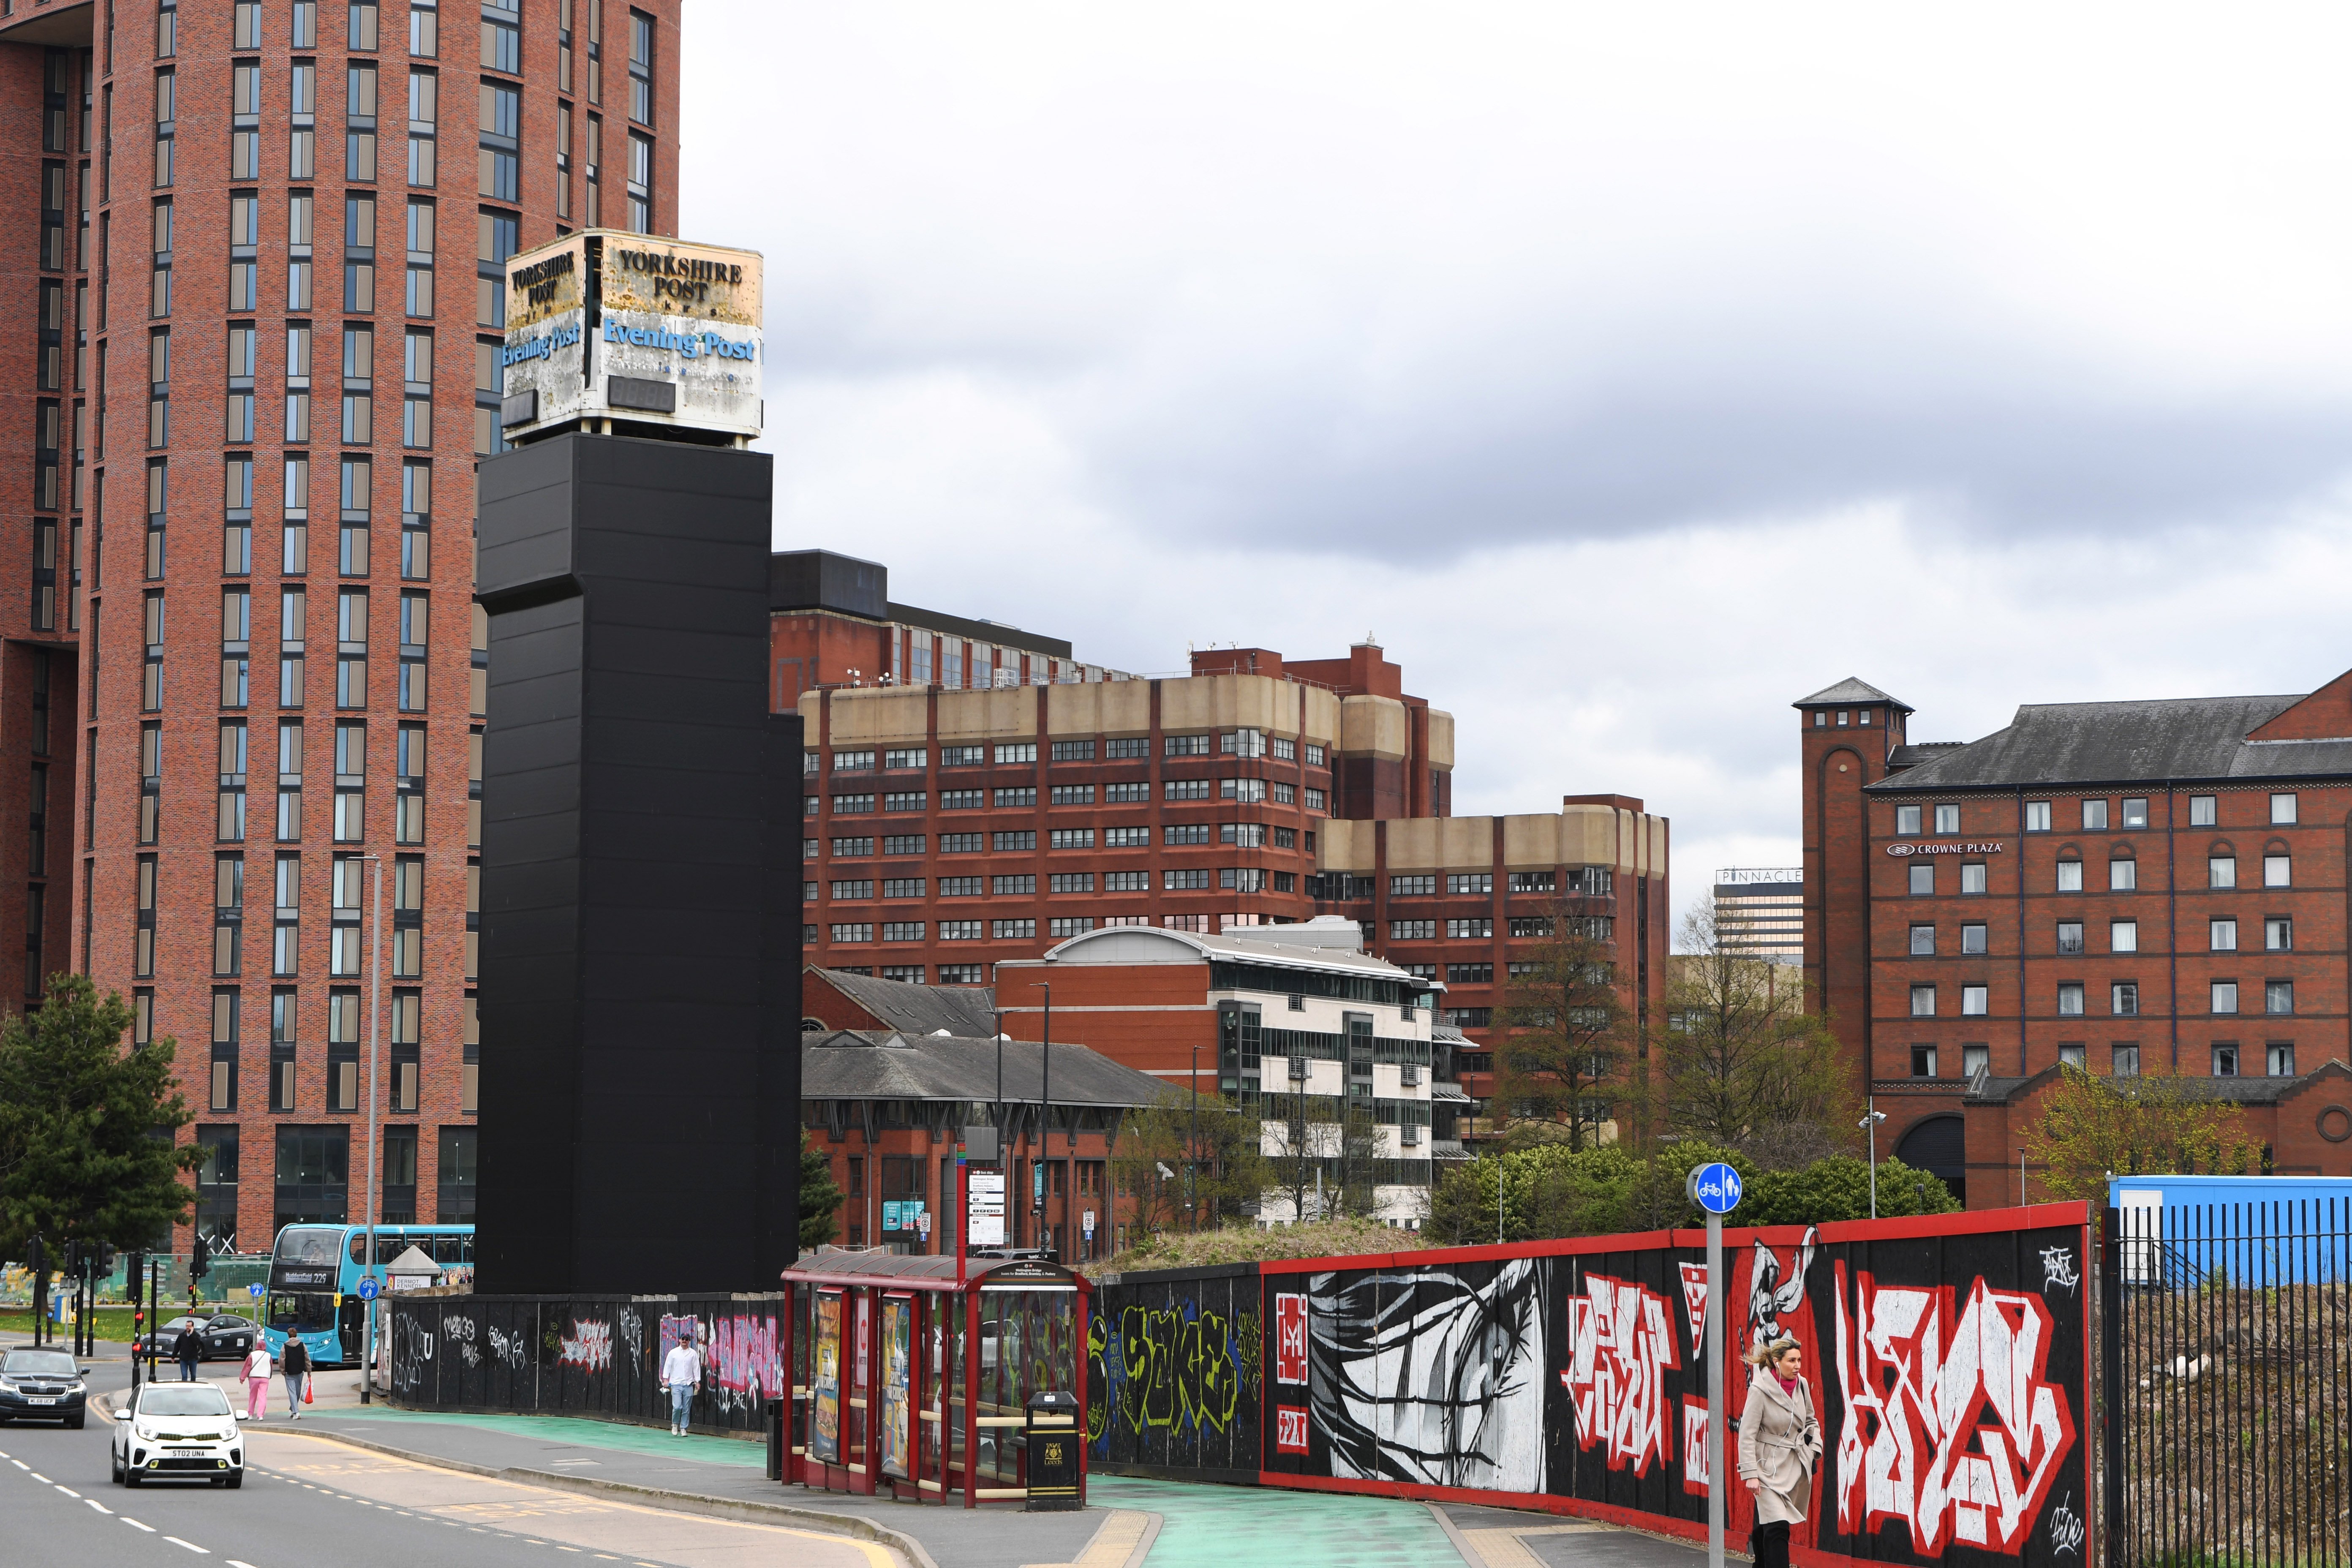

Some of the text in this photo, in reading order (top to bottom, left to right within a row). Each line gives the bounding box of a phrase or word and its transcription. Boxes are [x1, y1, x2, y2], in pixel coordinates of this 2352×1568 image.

[512, 250, 574, 291] YORKSHIRE
[620, 249, 742, 284] YORKSHIRE
[528, 279, 557, 309] POST
[654, 276, 708, 301] POST
[502, 321, 580, 367] Evening Post
[604, 318, 755, 362] Evening Post
[1918, 843, 2001, 854] CROWNE PLAZA
[1723, 870, 1802, 882] PINNACLE
[314, 1273, 327, 1283] 229
